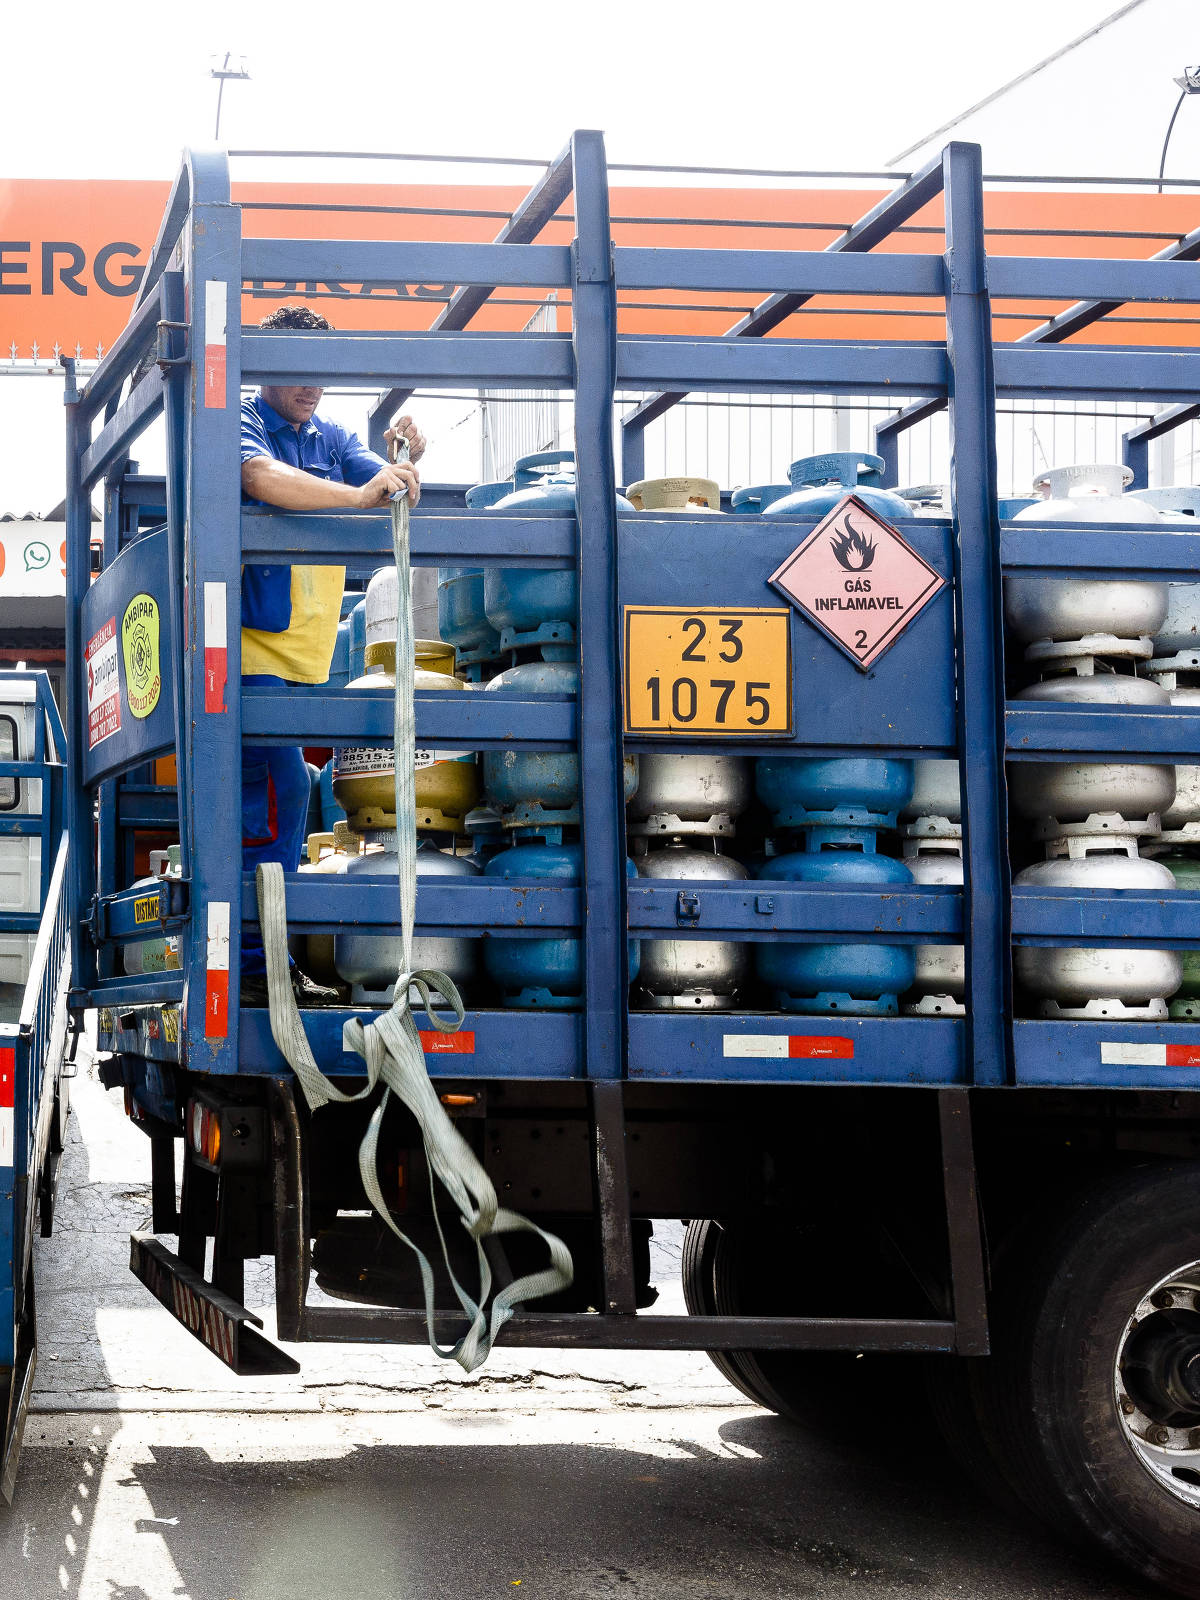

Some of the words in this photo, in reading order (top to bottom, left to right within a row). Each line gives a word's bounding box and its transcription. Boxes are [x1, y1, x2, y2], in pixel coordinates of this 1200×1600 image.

[844, 577, 872, 593] GÁS
[125, 601, 154, 634] AMBIPAR
[815, 597, 904, 611] INFLAMAVEL
[681, 618, 743, 663] 23
[854, 630, 868, 649] 2
[95, 653, 117, 687] ambipar
[147, 675, 160, 705] 2020
[646, 677, 770, 726] 1075
